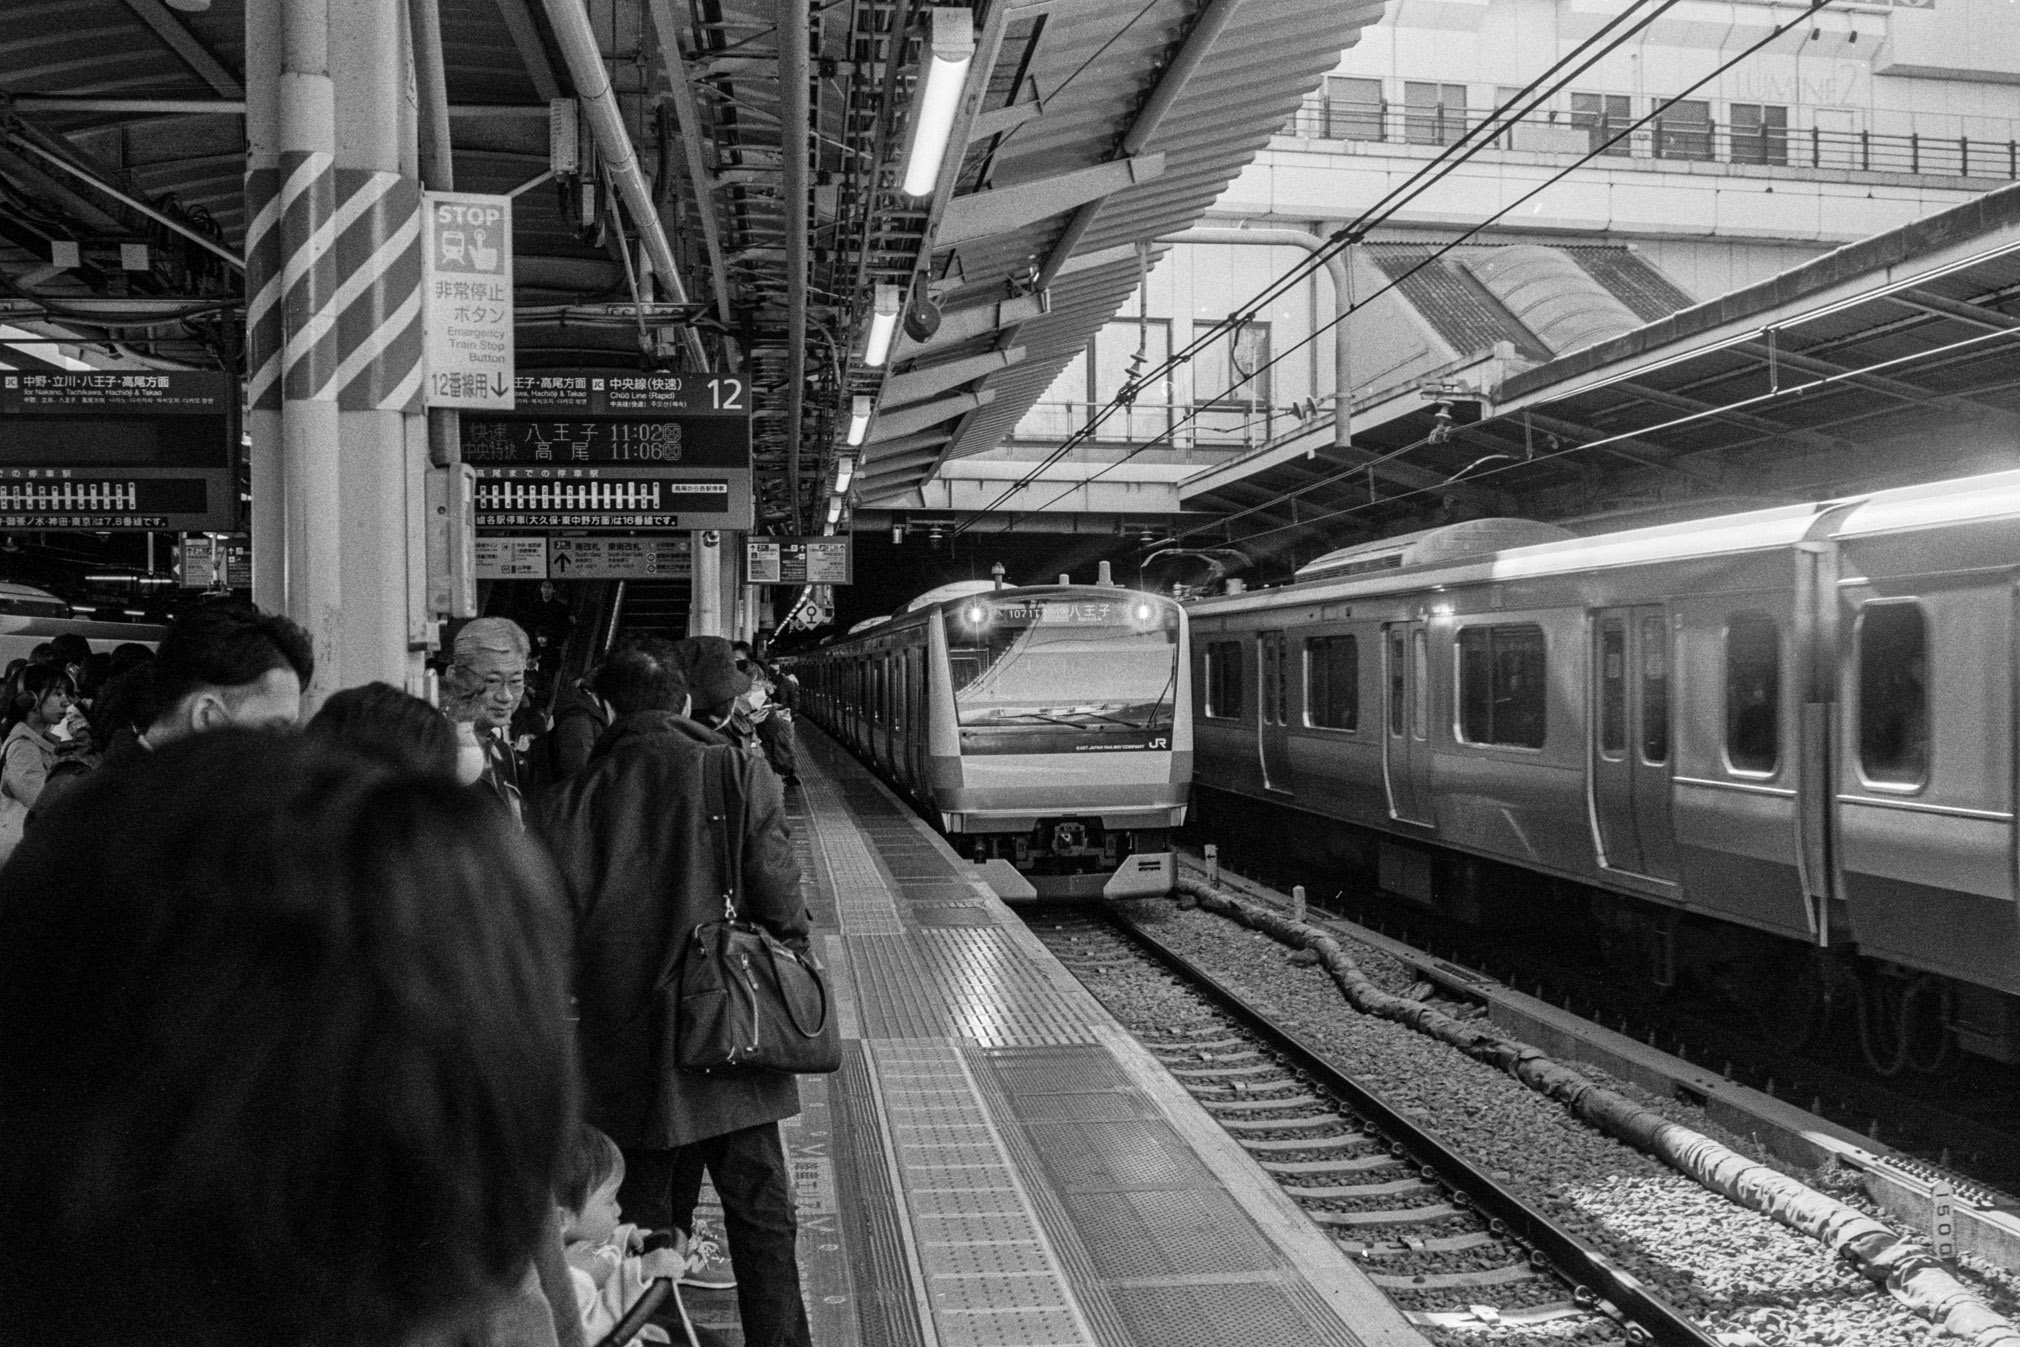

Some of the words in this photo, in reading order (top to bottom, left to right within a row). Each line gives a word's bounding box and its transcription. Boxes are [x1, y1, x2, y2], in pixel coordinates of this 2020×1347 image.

[437, 205, 501, 227] STOP
[435, 281, 505, 301] 非常停止
[447, 326, 505, 340] Emergency
[448, 338, 477, 349] Train
[479, 340, 505, 352] Stop
[468, 352, 506, 363] Button
[431, 372, 488, 399] 12番線用
[593, 379, 604, 390] JC
[609, 377, 683, 391] 中央線(快速)
[648, 391, 676, 400] (Rapid)
[706, 378, 743, 410] 12
[525, 423, 599, 442] 八王子
[611, 423, 663, 441] 11:02
[534, 441, 590, 461] 高尾
[611, 441, 663, 460] 11:06
[1069, 604, 1110, 617] 八王子
[1148, 737, 1167, 749] JR
